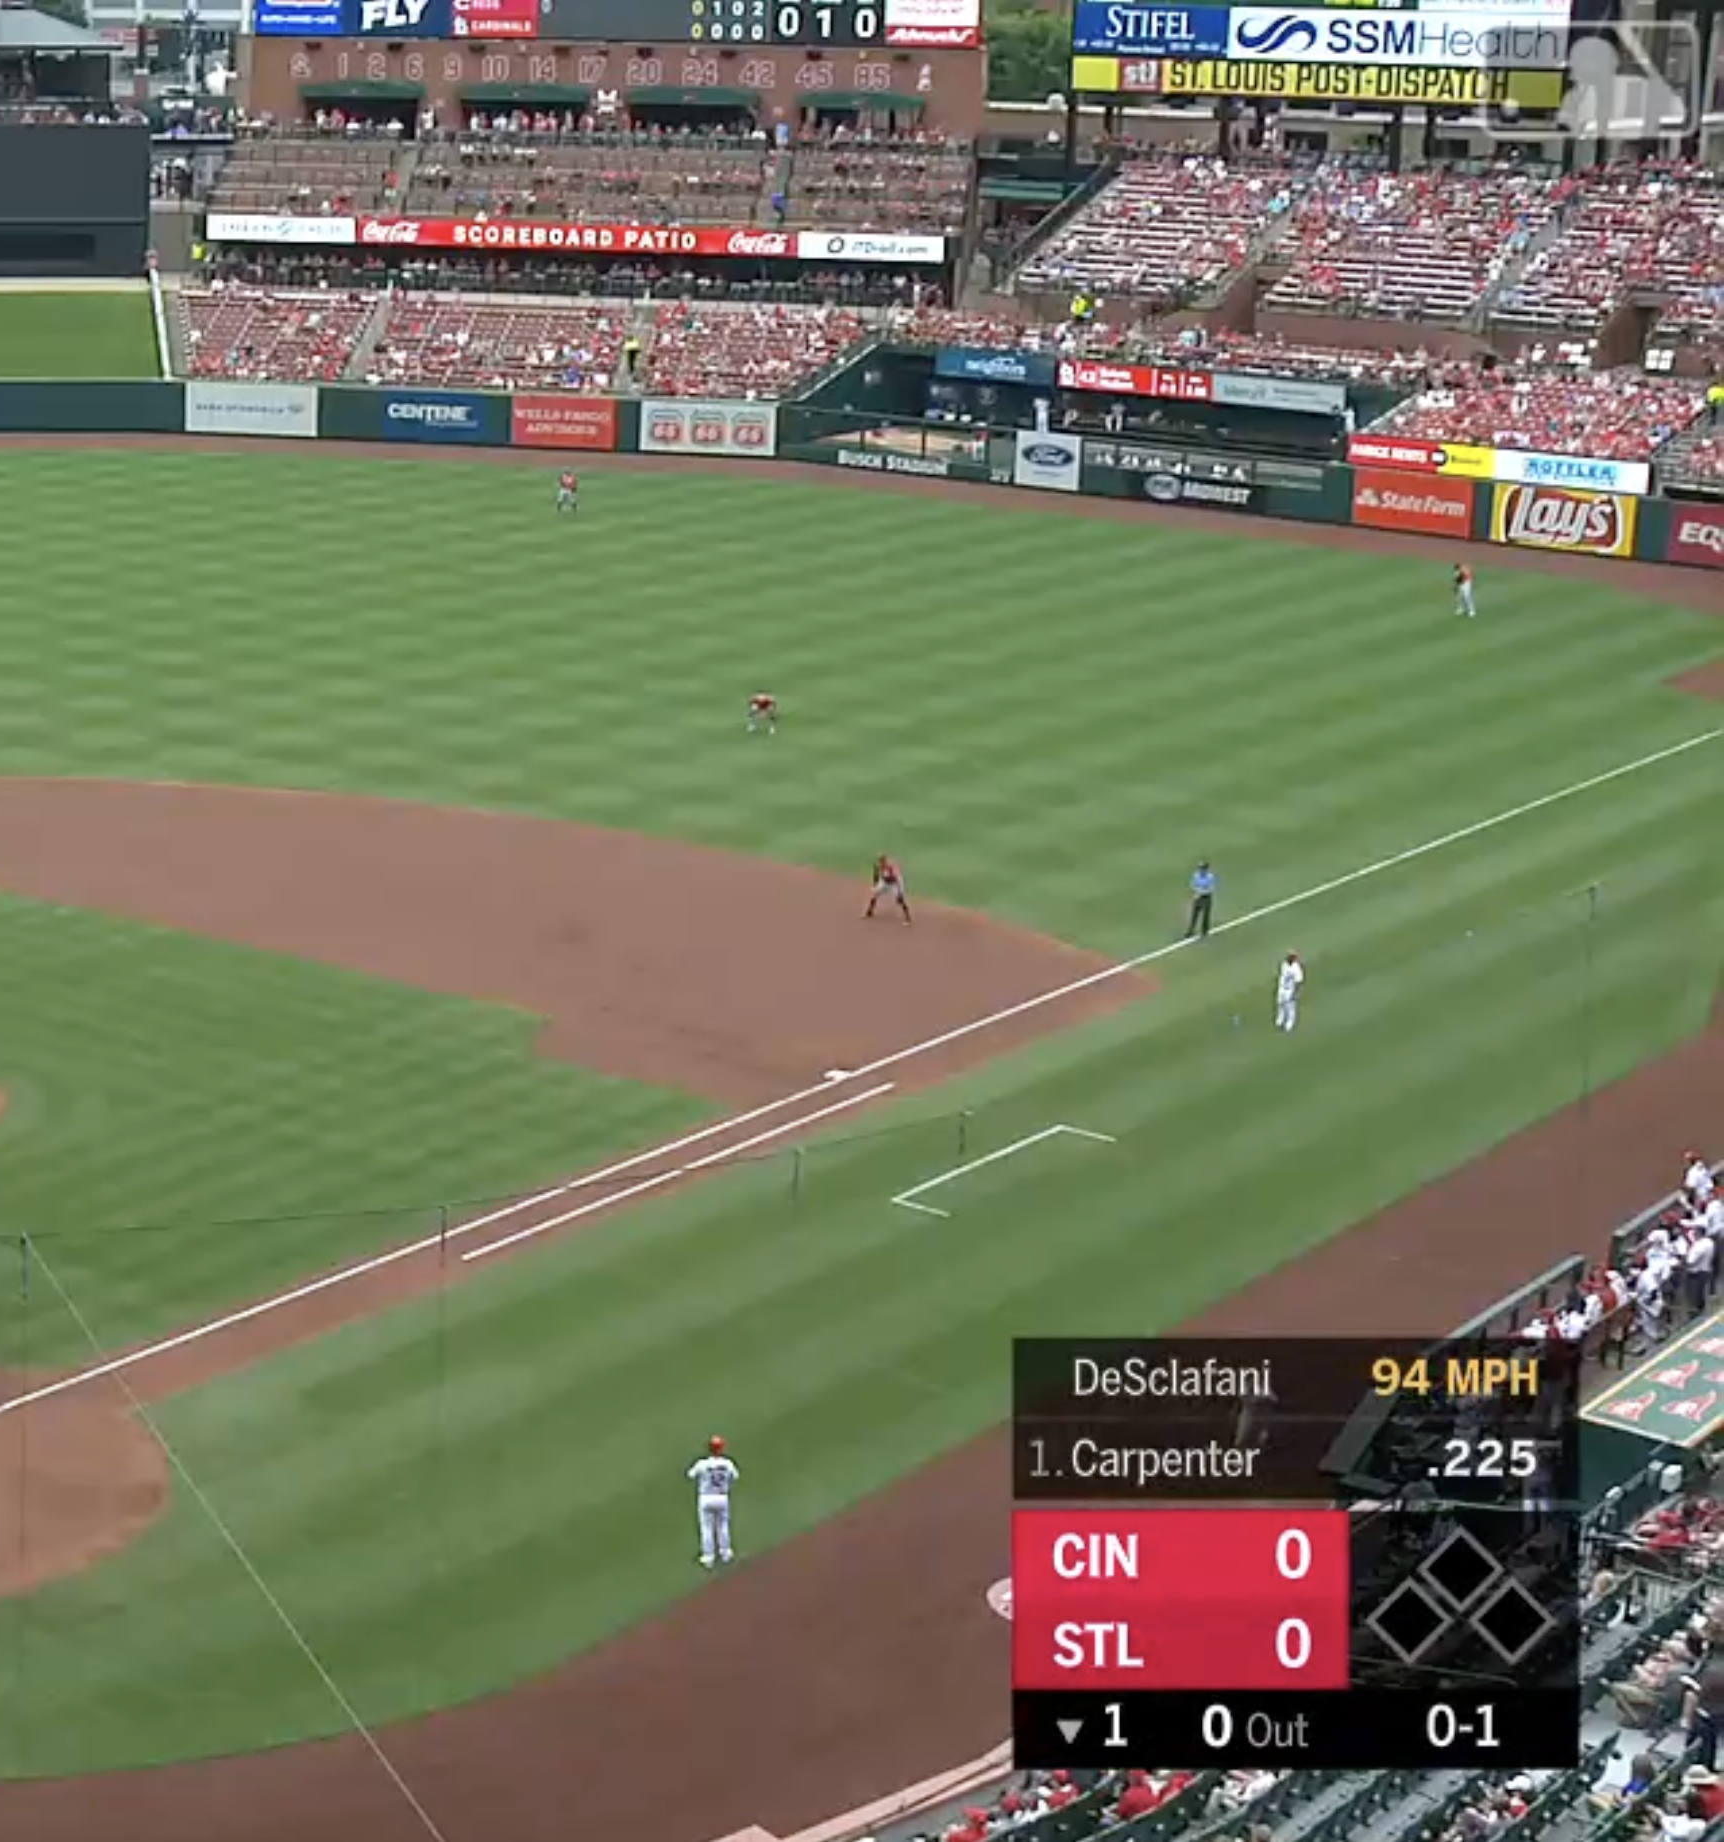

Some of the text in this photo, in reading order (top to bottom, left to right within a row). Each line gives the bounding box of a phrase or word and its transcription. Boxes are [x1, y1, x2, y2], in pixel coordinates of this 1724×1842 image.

[361, 0, 426, 30] FLY
[712, 1, 721, 15] 1
[732, 1, 744, 15] 0
[751, 1, 764, 15] 2
[778, 7, 877, 38] 0 1 0
[1105, 6, 1195, 40] STIFEL
[471, 20, 532, 32] CARDINALS
[691, 23, 764, 39] 0 0 0 0
[366, 52, 386, 80] 2
[405, 53, 424, 80] 6
[482, 54, 510, 81] 10
[626, 57, 662, 86] 20
[1212, 63, 1284, 91] LOUIS
[1295, 67, 1509, 101] POST-DISPATCH
[453, 225, 697, 249] SCOREBOARD PATIO
[838, 450, 948, 475] BUSCH STADIUM
[1508, 487, 1613, 545] Lay's
[1679, 521, 1724, 552] EQ
